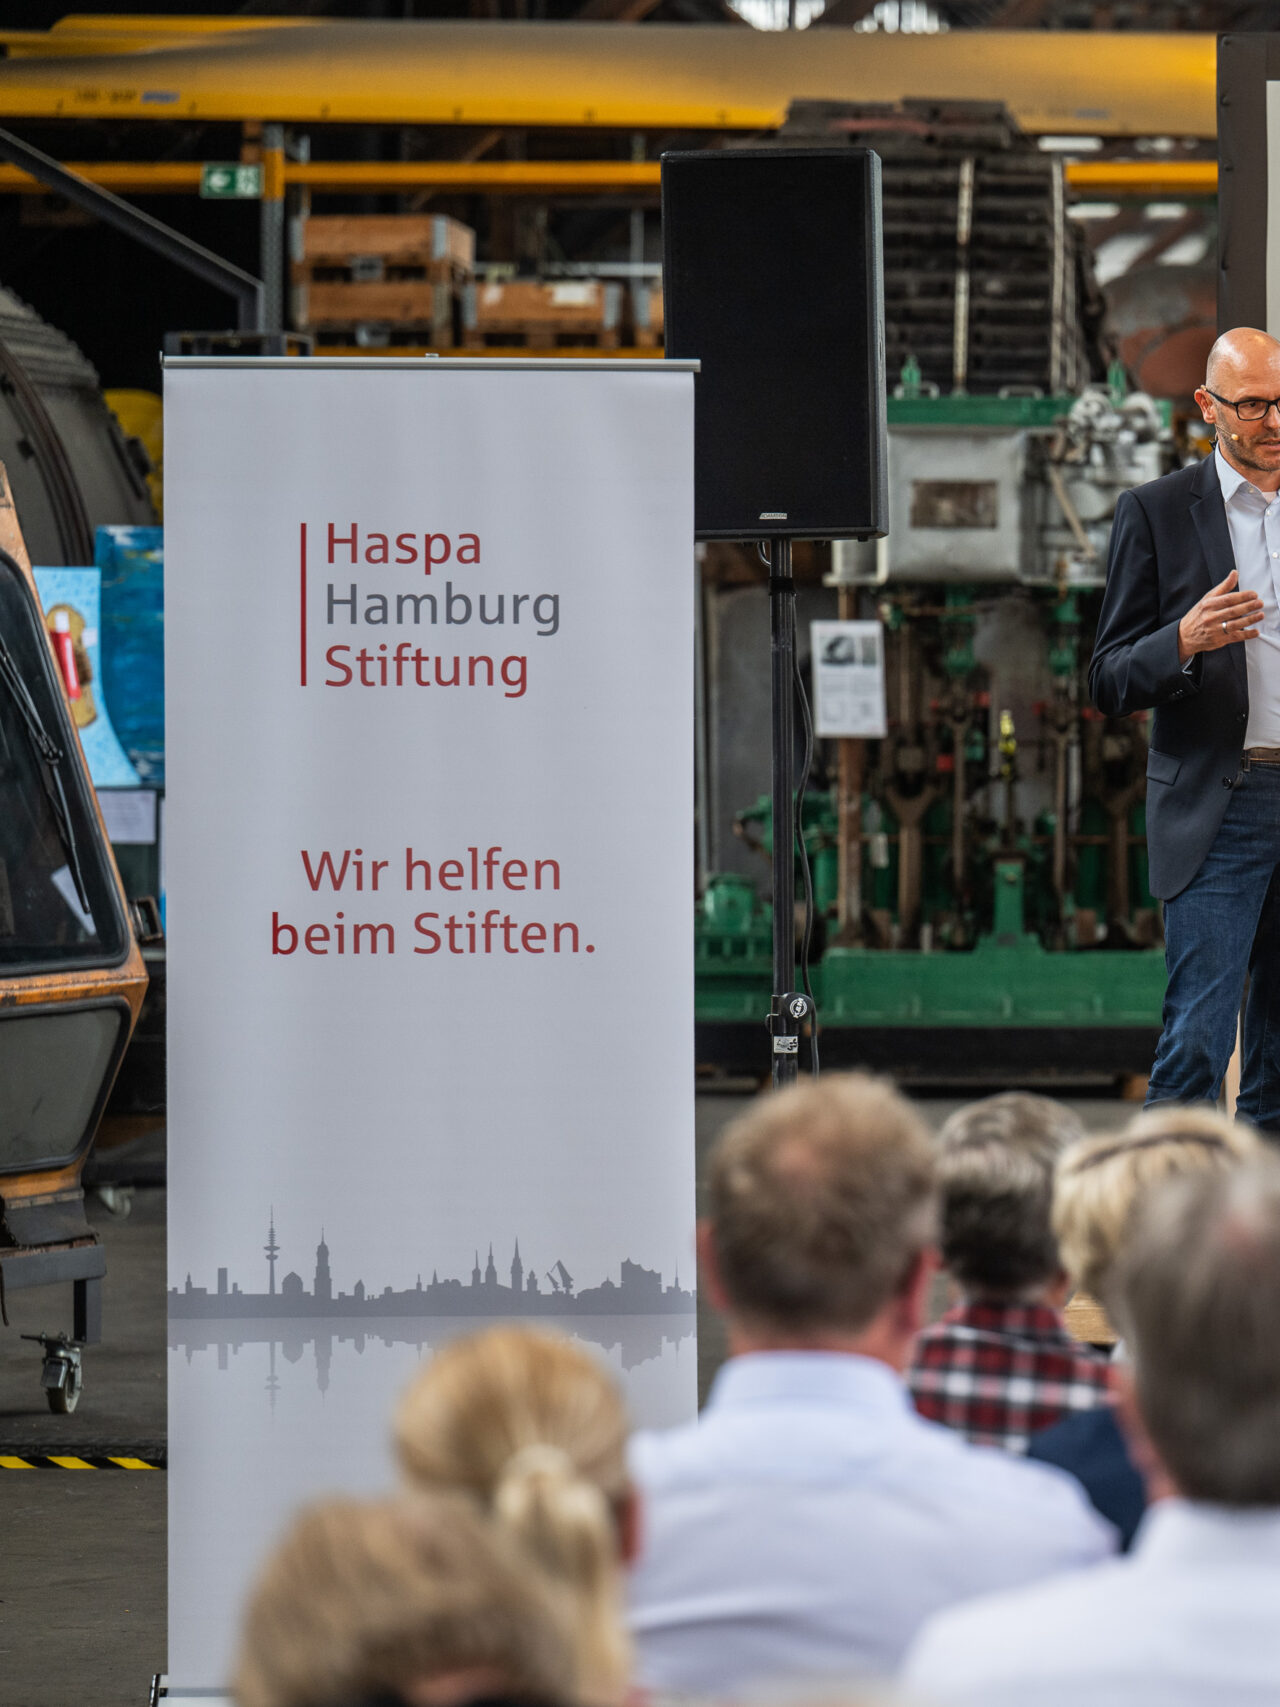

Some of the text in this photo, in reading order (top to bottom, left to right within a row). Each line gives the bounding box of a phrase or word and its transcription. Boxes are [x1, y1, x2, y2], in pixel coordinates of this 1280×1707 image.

[328, 523, 480, 575] Haspa
[327, 581, 559, 636] Hamburg
[325, 643, 527, 698] Stiftung
[301, 846, 560, 891] Wir helfen
[272, 910, 595, 955] beim Stiften.
